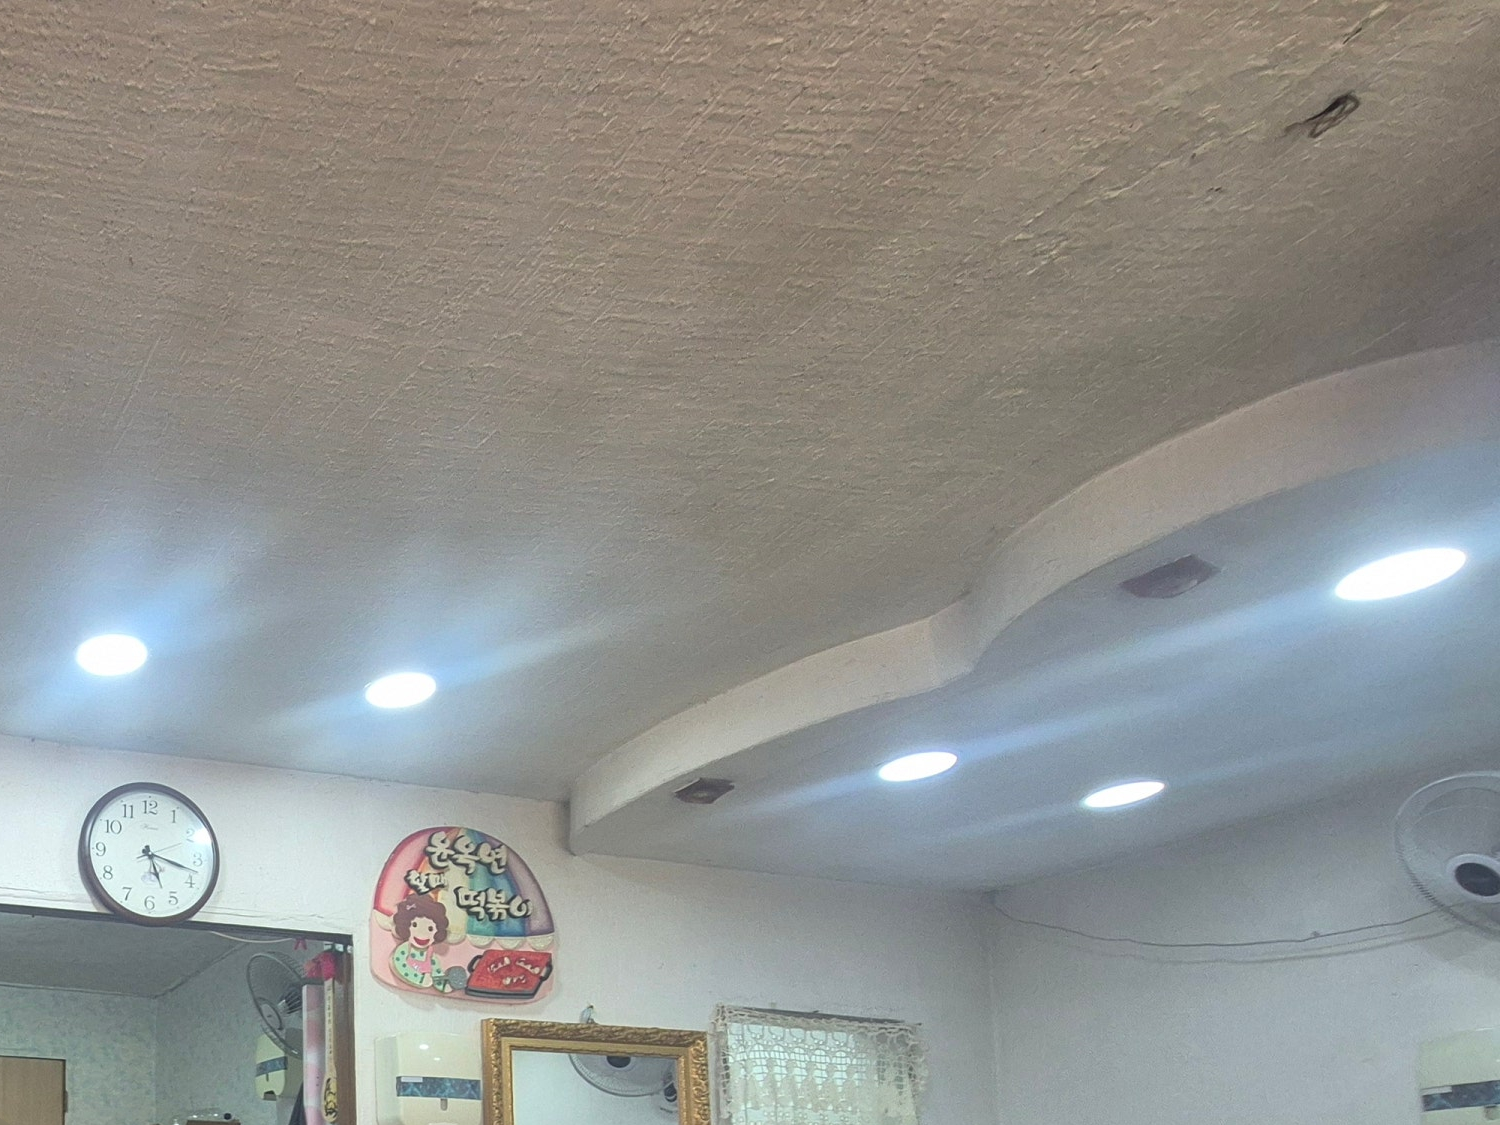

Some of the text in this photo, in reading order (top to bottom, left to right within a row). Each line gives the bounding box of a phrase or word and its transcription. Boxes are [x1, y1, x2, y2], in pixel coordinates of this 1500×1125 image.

[122, 804, 134, 819] 11
[142, 800, 158, 815] 12
[171, 809, 177, 823] 1
[105, 819, 122, 834] 10
[95, 842, 106, 857] 9
[426, 831, 508, 874] 윤옥연
[193, 854, 203, 867] 3
[103, 865, 113, 880] 8
[185, 874, 196, 888] 4
[122, 887, 132, 901] 7
[169, 891, 179, 905] 5
[144, 896, 155, 910] 6
[457, 886, 533, 920] 떡볶이
